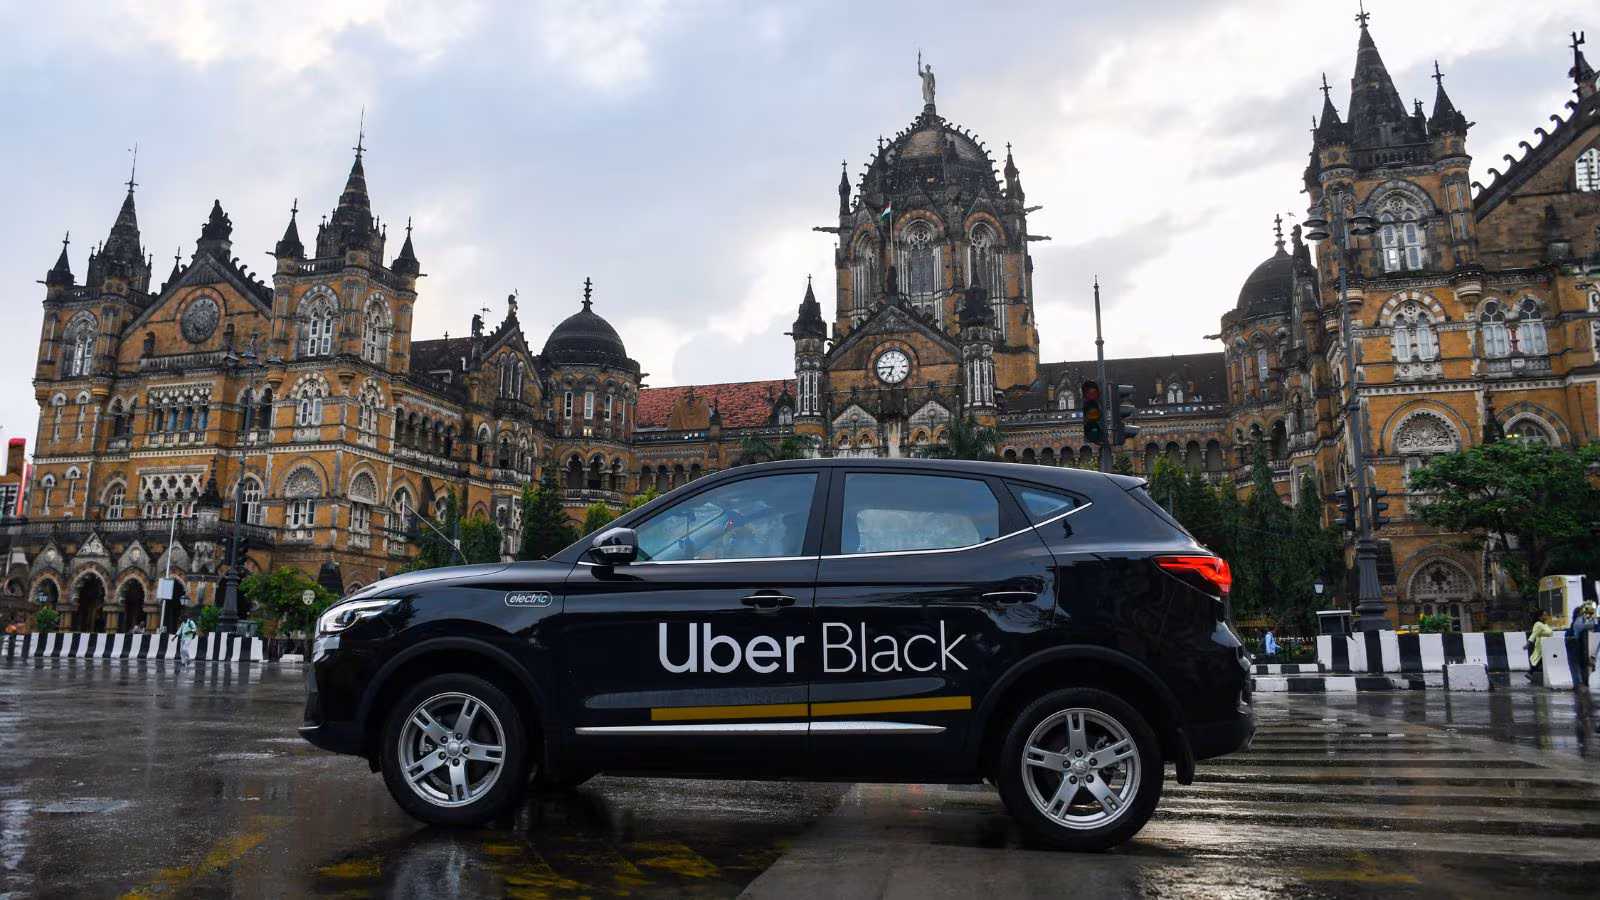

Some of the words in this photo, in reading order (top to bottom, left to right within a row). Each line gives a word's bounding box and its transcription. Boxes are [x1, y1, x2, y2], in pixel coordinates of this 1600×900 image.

[509, 593, 548, 603] electric
[658, 622, 805, 674] Uber
[822, 620, 969, 673] Black
